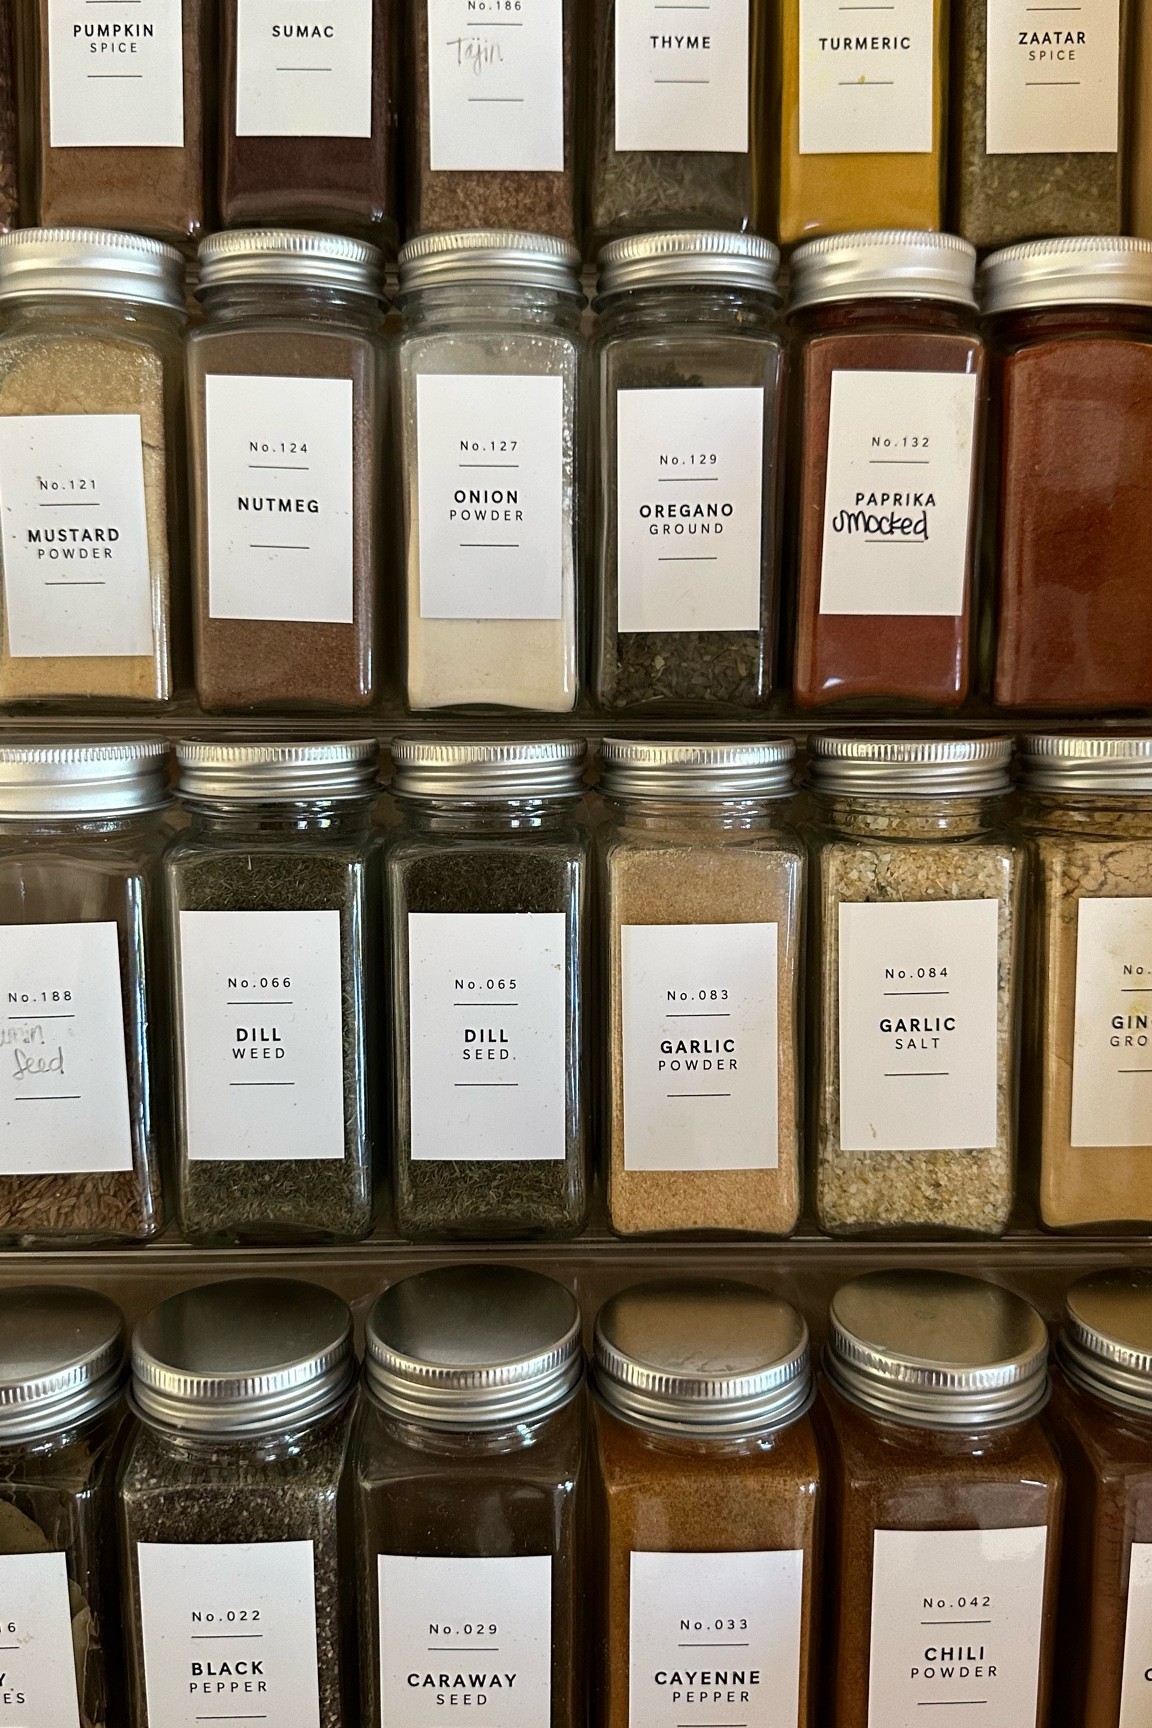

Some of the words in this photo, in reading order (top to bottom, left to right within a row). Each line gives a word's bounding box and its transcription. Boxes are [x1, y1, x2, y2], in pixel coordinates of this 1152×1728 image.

[467, 0, 522, 11] No.186
[73, 23, 154, 38] PUMPKIN
[271, 24, 334, 39] SUMAC
[649, 35, 711, 50] THYME
[818, 36, 911, 52] TURMERIC
[1018, 30, 1086, 46] ZAATAR
[89, 41, 138, 54] SPICE
[1028, 49, 1076, 62] SPICE
[249, 441, 308, 454] No.124
[459, 440, 519, 452] No.127
[871, 436, 929, 448] No.132
[659, 453, 717, 466] No.129
[39, 479, 97, 491] No.121
[453, 489, 518, 505] ONION
[854, 492, 937, 508] PAPRIKA
[237, 496, 319, 514] NUTMEG
[638, 502, 734, 519] OREGANO
[449, 509, 523, 522] POWDER
[27, 527, 120, 544] MUSTARD
[649, 522, 724, 536] GROUND
[37, 547, 113, 560] POWDER
[885, 967, 948, 980] No.084
[227, 976, 291, 989] No.066
[454, 978, 517, 990] No.065
[8, 990, 72, 1003] No.188
[666, 989, 729, 1001] No.083
[879, 1017, 956, 1033] GARLIC
[1111, 1014, 1152, 1029] GIN
[236, 1027, 282, 1043] DILL
[464, 1028, 509, 1044] DILL
[659, 1038, 735, 1055] GARLIC
[894, 1037, 940, 1050] SALT
[231, 1047, 285, 1060] WEED
[462, 1048, 509, 1061] SEED
[658, 1058, 738, 1072] POWDER
[923, 1595, 991, 1609] No.042
[191, 1609, 261, 1623] No.022
[429, 1623, 497, 1635] No.029
[680, 1618, 748, 1631] No.033
[923, 1645, 985, 1662] CHILI
[191, 1660, 264, 1677] BLACK
[910, 1665, 997, 1679] POWDER
[406, 1672, 517, 1689] CARAWAY
[654, 1670, 760, 1686] CAYENNE
[189, 1680, 268, 1694] PEPPER
[436, 1693, 487, 1706] SEED
[672, 1690, 750, 1703] PEPPER
